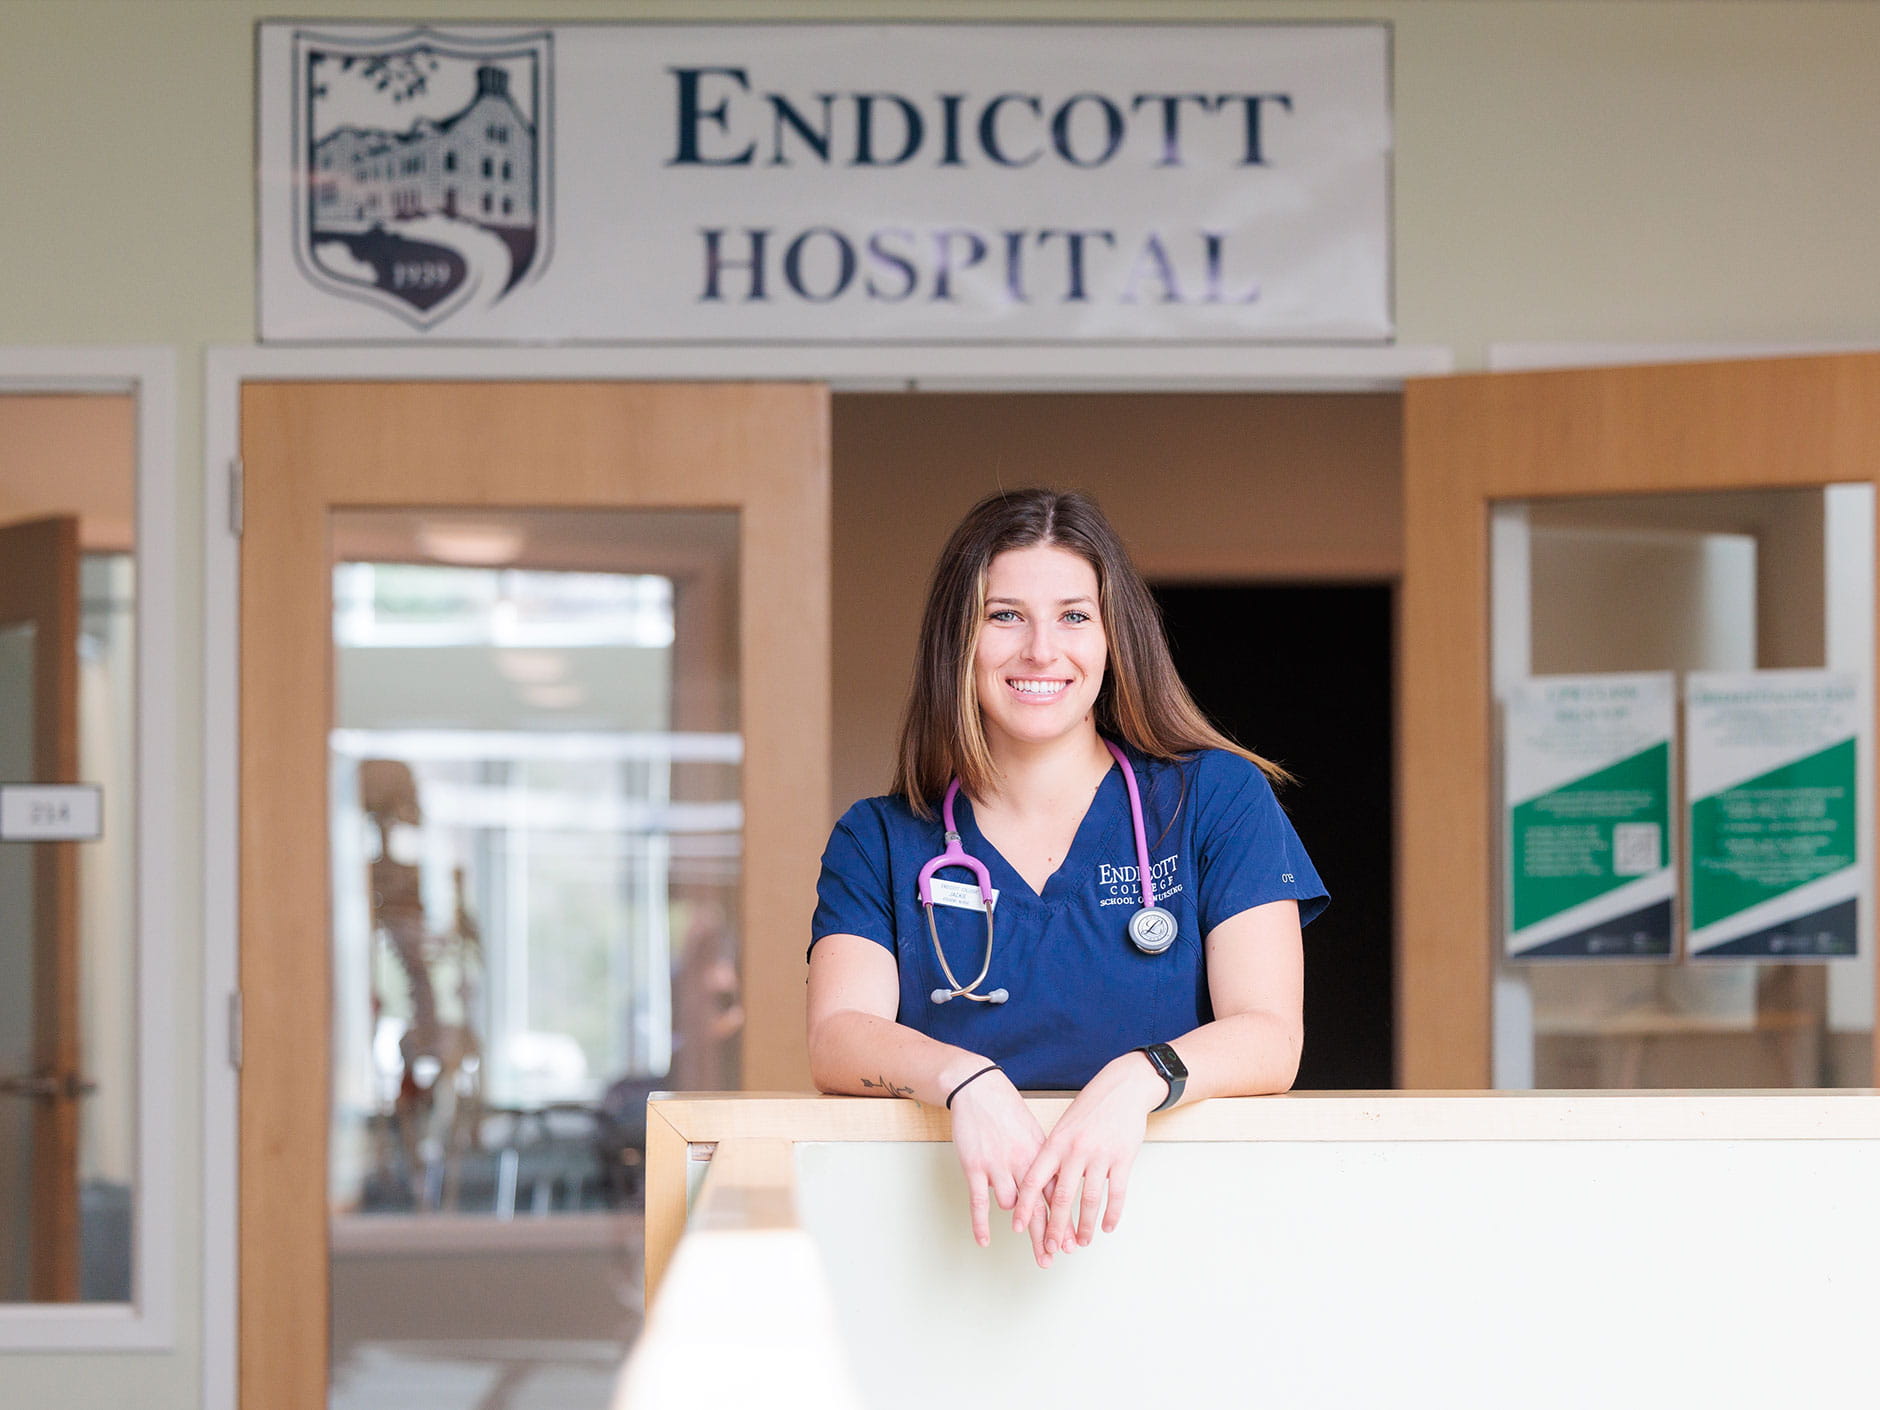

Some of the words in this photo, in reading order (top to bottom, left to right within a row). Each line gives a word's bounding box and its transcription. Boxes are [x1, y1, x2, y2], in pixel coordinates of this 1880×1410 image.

[665, 67, 1293, 168] ENDICOTT
[697, 228, 1261, 303] HOSPITAL
[1100, 897, 1134, 907] SCHOOL
